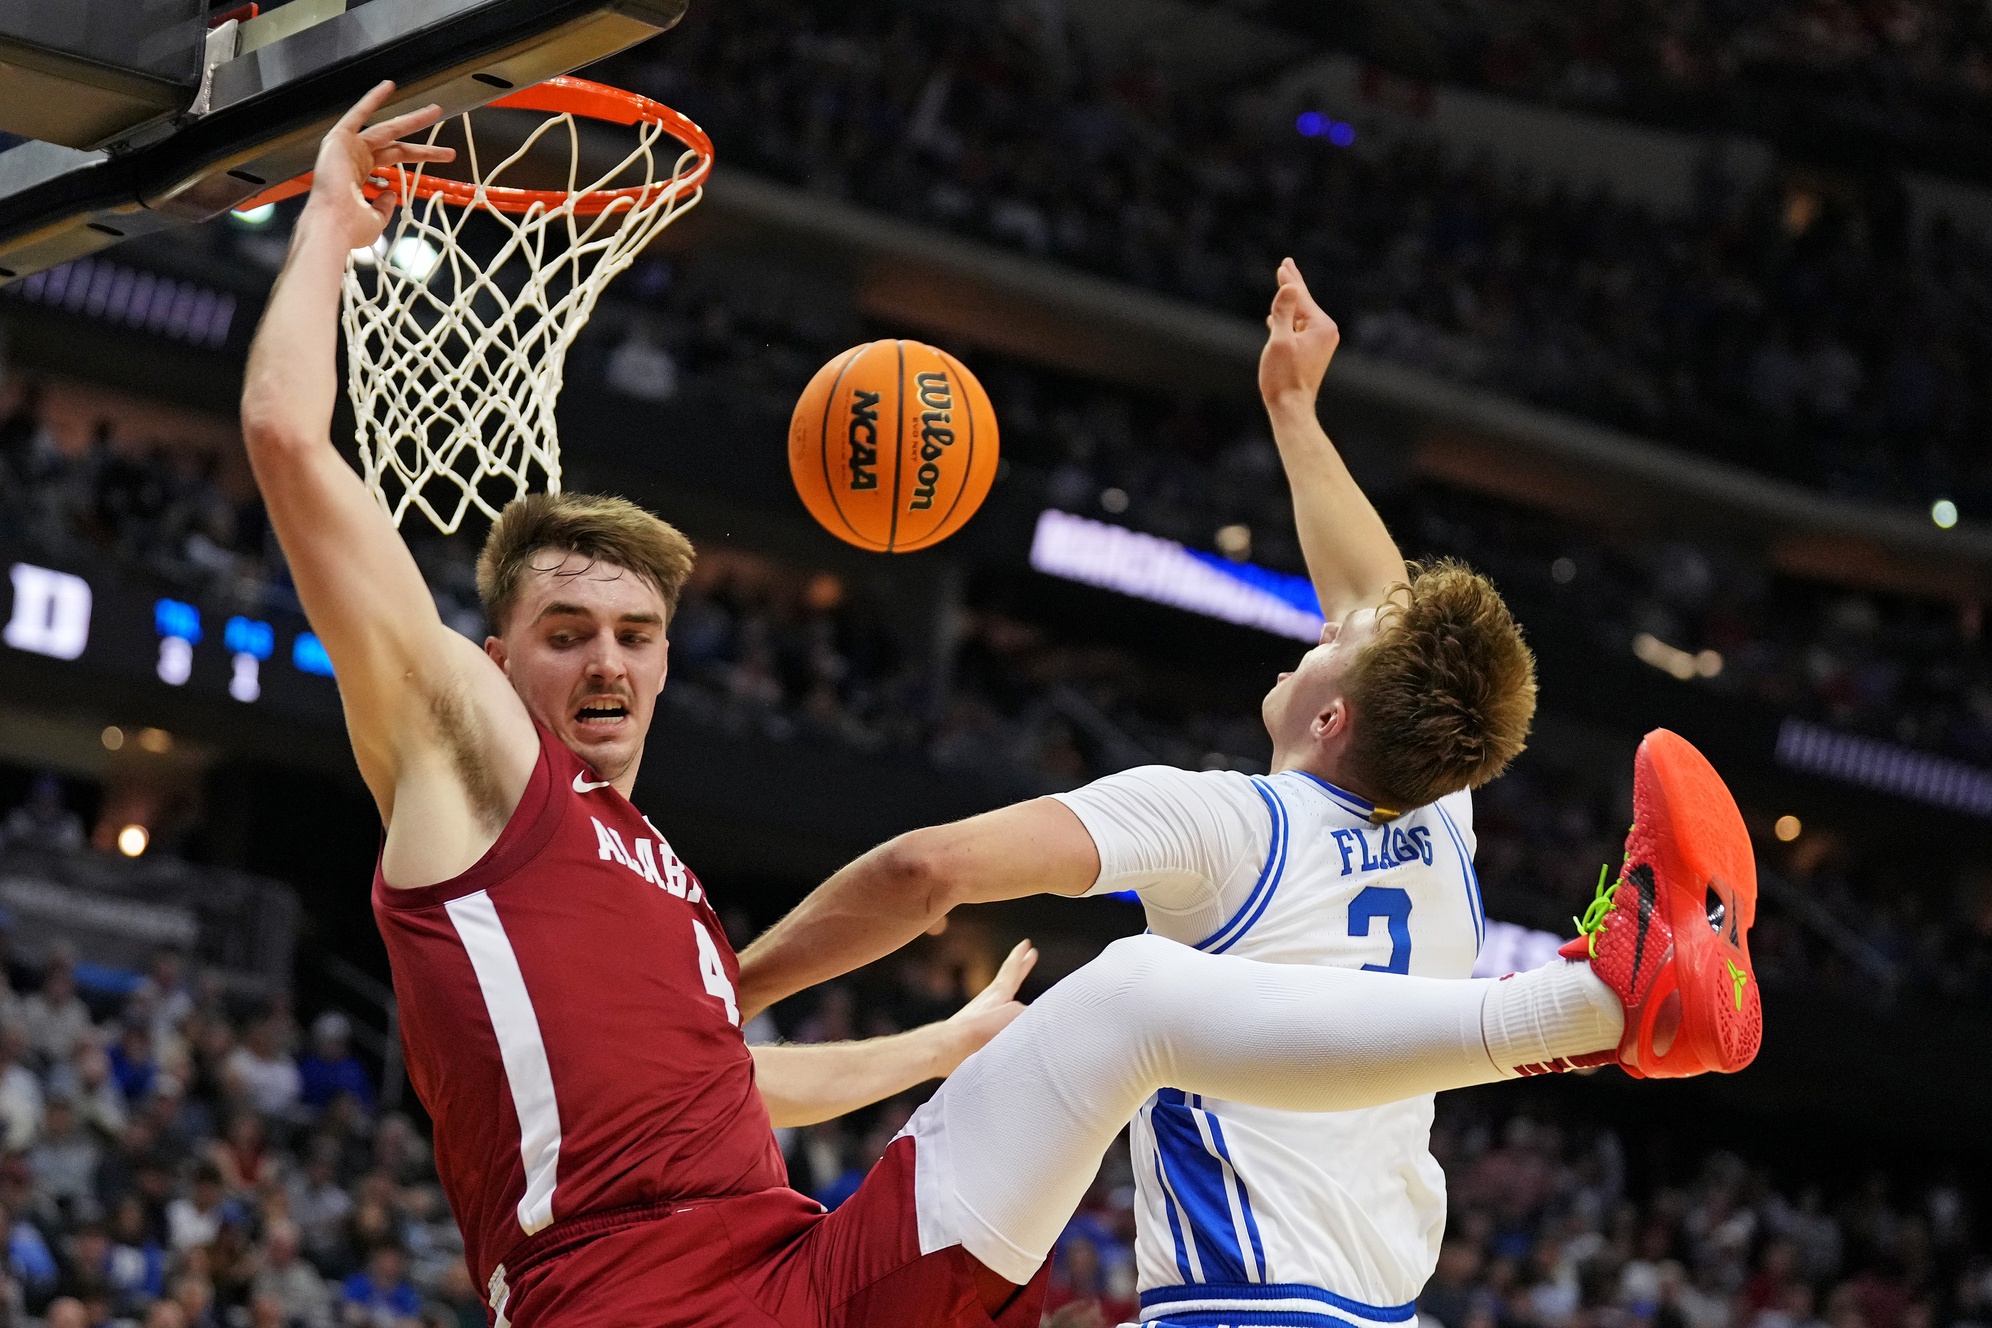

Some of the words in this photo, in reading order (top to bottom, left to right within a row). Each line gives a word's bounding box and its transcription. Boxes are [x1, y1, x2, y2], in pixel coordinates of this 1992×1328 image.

[849, 388, 881, 491] NCAA
[912, 371, 955, 512] Wilson
[590, 815, 713, 910] ALAB
[1330, 822, 1433, 876] FLAGG
[691, 918, 740, 1028] 4
